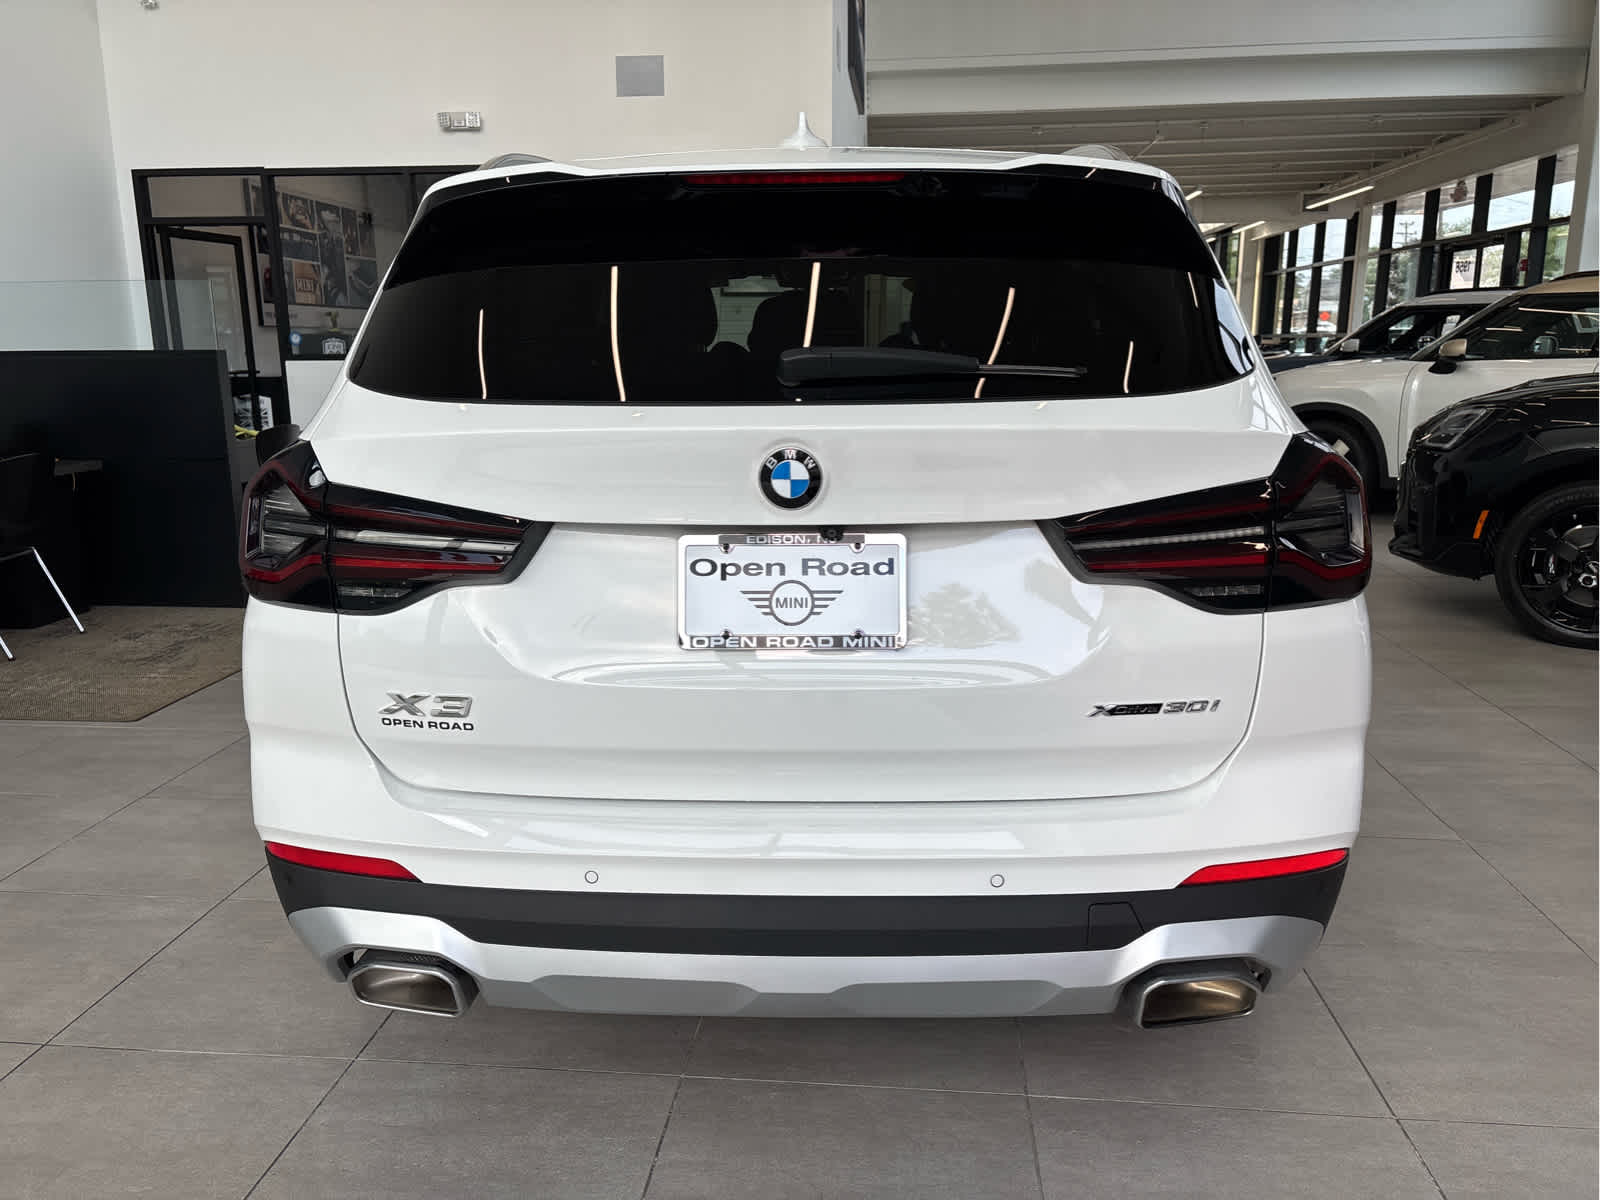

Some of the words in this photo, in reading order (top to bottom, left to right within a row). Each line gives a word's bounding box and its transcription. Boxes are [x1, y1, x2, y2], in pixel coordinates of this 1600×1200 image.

[765, 449, 817, 470] BMW
[746, 535, 811, 544] EDISON,
[689, 557, 786, 581] Open
[801, 557, 895, 576] Road
[775, 597, 809, 609] MINI
[691, 636, 758, 648] OPEN
[766, 636, 834, 648] ROAD
[842, 636, 893, 648] MINI
[378, 692, 472, 718] X3
[381, 717, 424, 729] OPEN
[427, 720, 474, 731] ROAD
